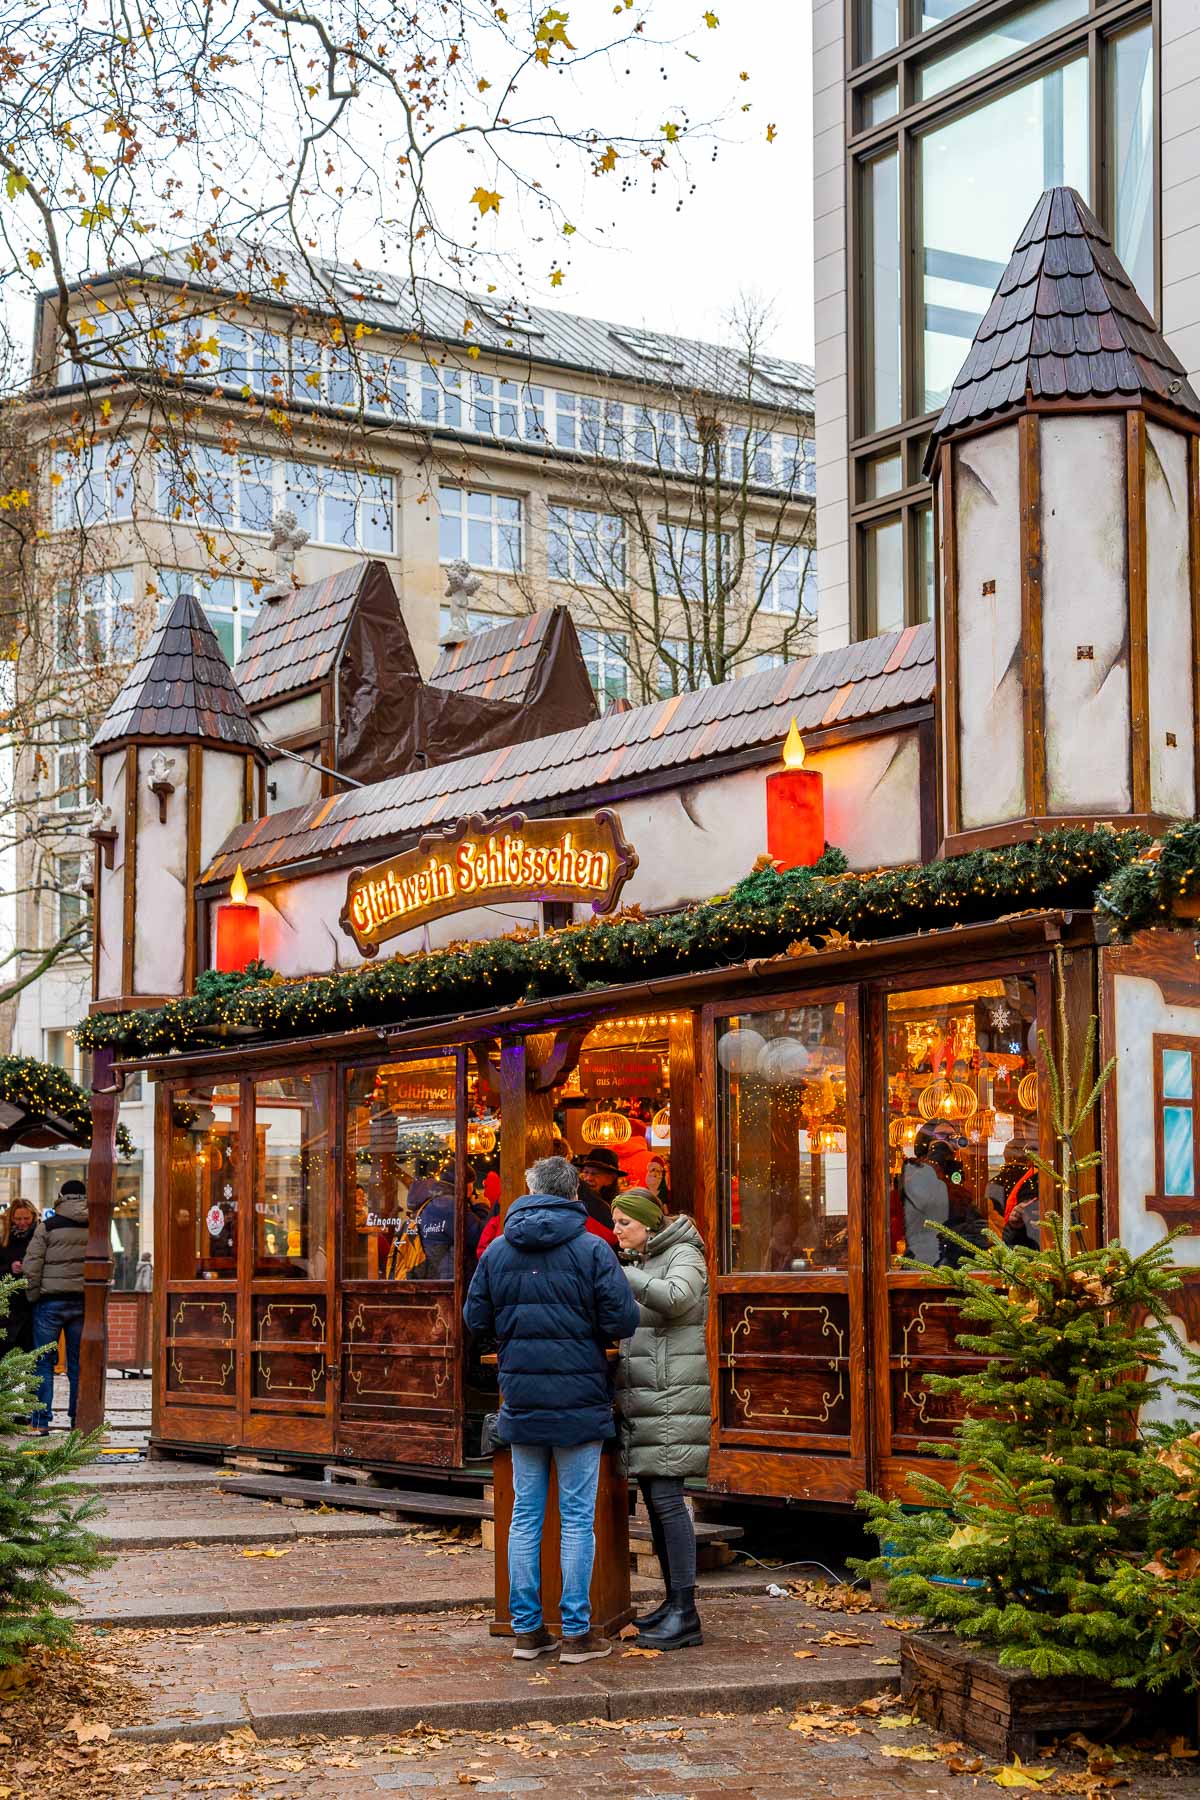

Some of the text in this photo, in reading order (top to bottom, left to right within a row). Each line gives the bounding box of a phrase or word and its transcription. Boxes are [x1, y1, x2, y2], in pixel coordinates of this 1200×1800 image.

[351, 833, 609, 934] Glühwein Schlösschen
[366, 1213, 402, 1232] Eingang
